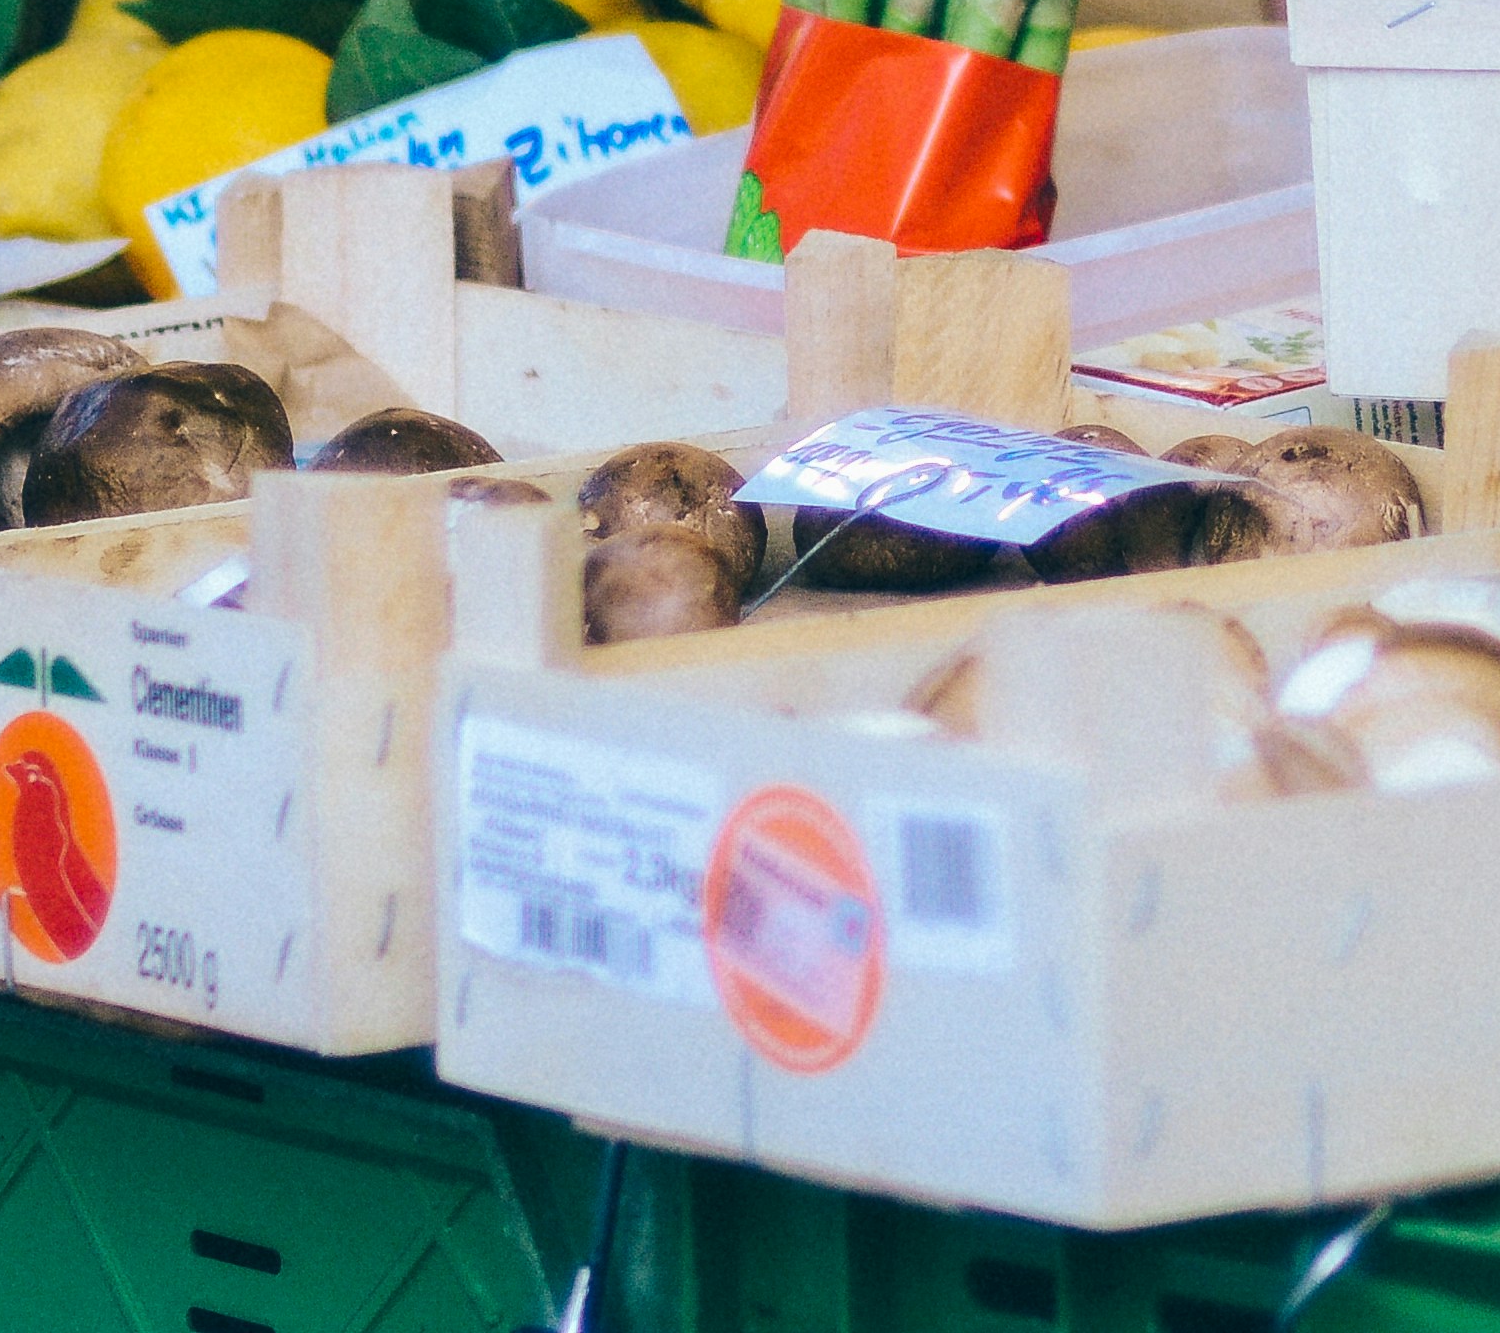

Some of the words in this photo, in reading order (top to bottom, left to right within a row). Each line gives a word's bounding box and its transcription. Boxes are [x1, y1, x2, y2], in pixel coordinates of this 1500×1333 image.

[131, 663, 244, 734] Clementinen
[136, 920, 197, 990] 2500
[203, 949, 219, 1011] g
